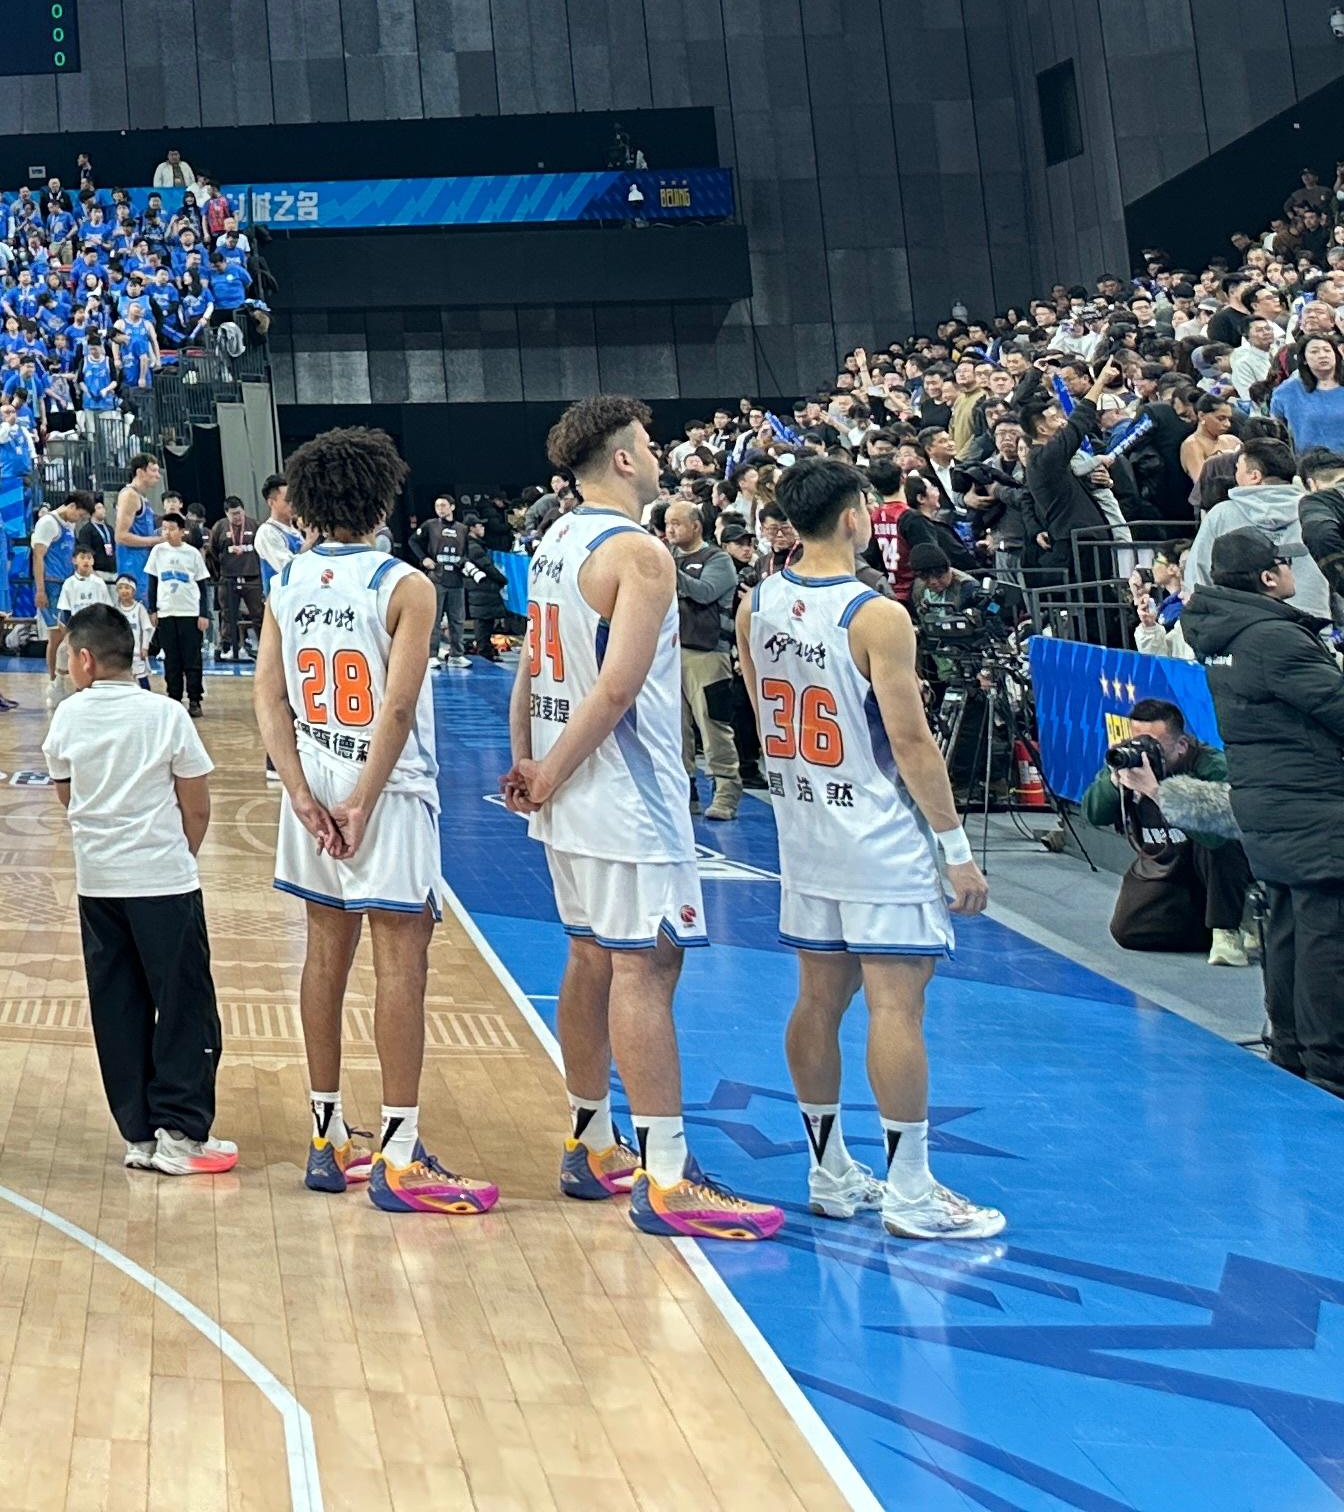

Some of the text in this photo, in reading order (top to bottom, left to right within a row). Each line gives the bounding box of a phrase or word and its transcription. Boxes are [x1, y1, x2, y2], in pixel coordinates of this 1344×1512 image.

[51, 4, 63, 19] 0
[53, 27, 64, 42] 0
[54, 51, 66, 66] 0
[659, 187, 691, 208] BEIJING
[294, 603, 355, 635] 伊力特
[527, 599, 565, 683] 34
[296, 647, 375, 727] 28
[761, 677, 844, 768] 36
